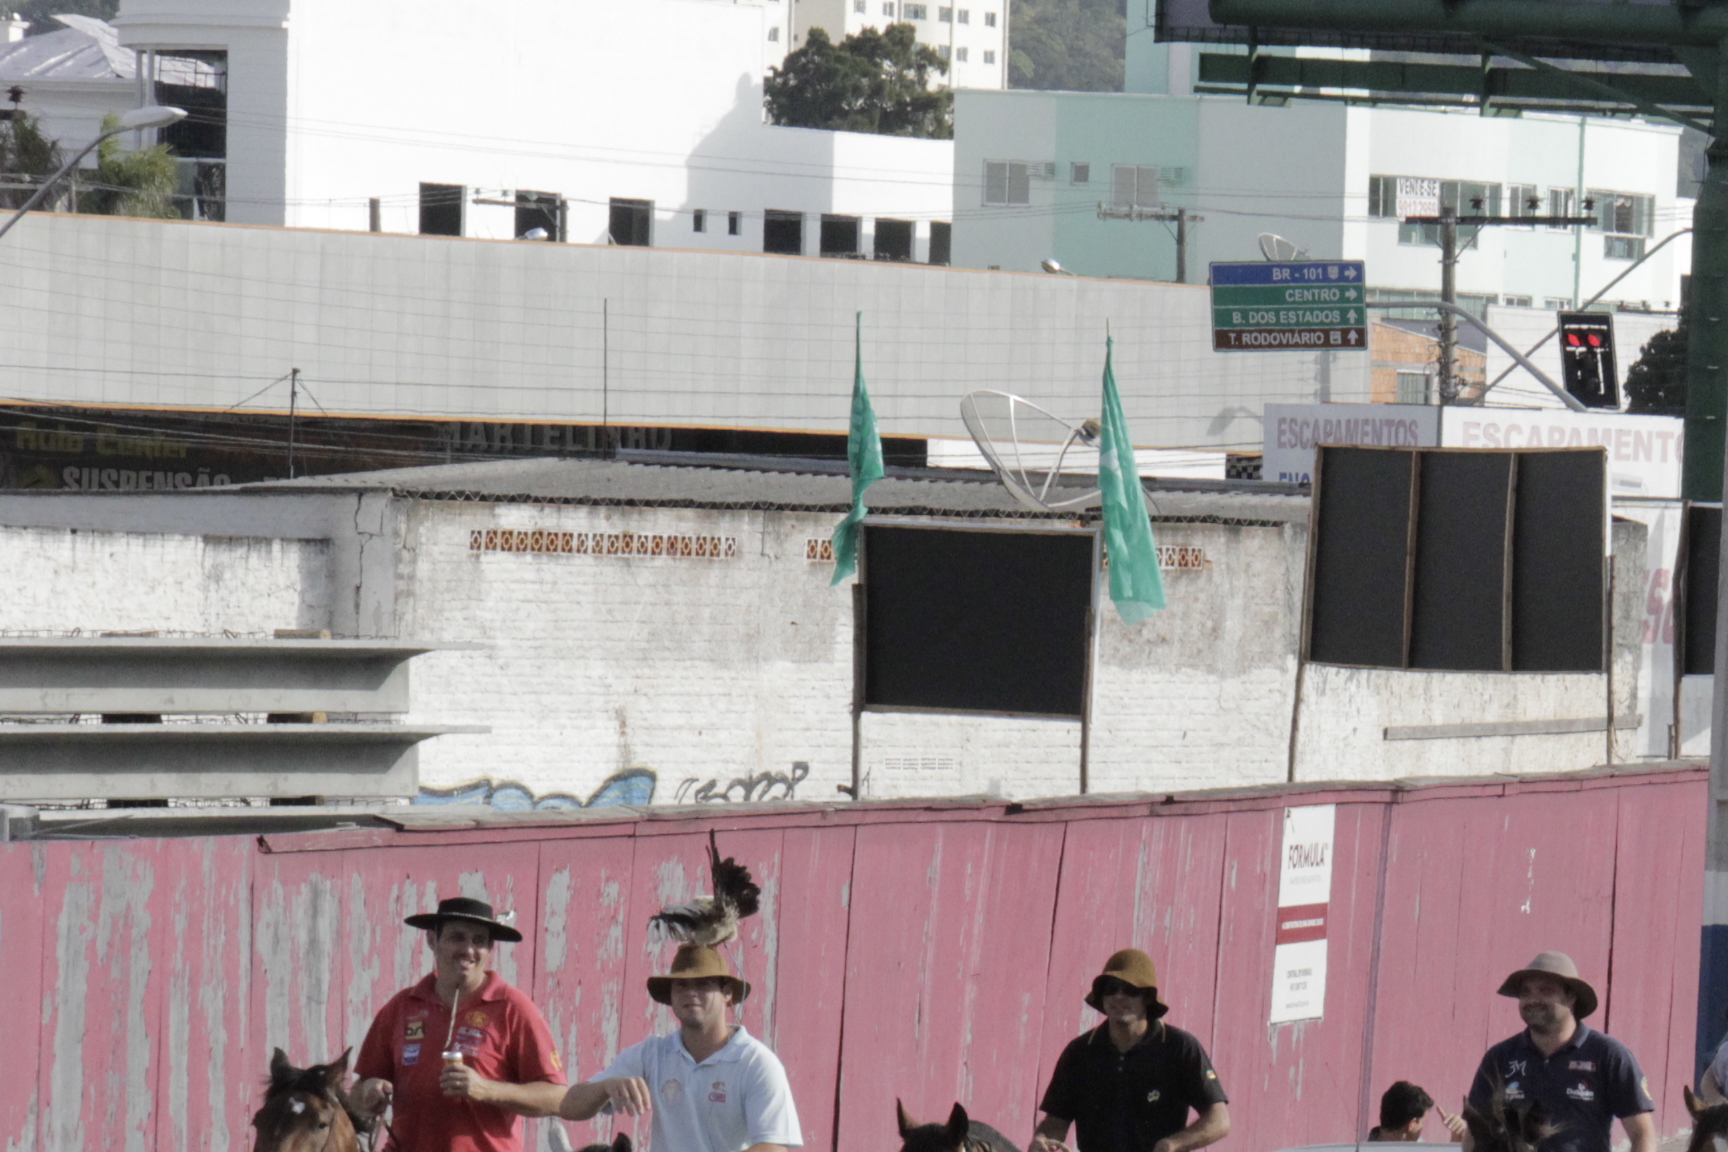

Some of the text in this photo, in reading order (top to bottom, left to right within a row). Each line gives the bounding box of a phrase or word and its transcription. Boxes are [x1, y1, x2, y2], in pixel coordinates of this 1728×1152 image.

[1272, 268, 1291, 280] BR
[1303, 268, 1323, 280] 101
[1285, 288, 1340, 301] CENTRO
[1232, 311, 1340, 324] B. DOS ESTADOS
[1228, 329, 1324, 345] T. RODOVIÁRIO
[1277, 416, 1420, 449] ESCAPAMENTOS
